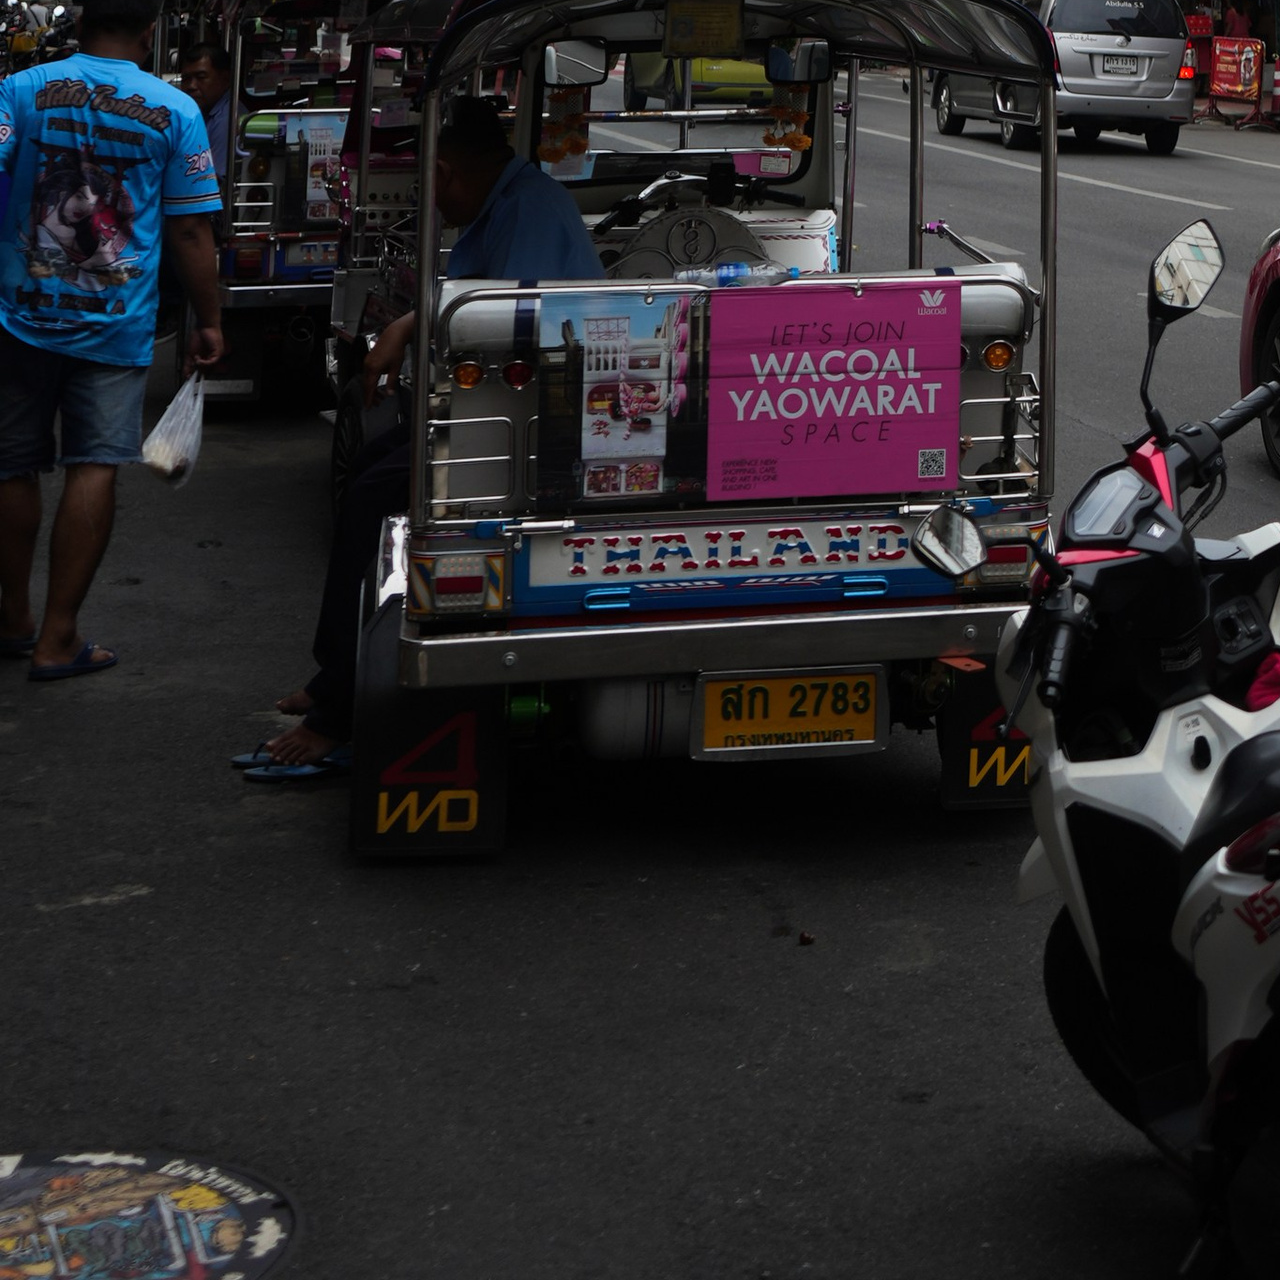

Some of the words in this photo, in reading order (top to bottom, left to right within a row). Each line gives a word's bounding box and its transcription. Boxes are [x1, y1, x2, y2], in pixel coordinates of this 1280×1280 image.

[1105, 0, 1132, 8] Abdulla
[917, 306, 947, 316] Wacoal
[770, 321, 833, 347] LET'S
[842, 320, 906, 347] JOIN
[750, 347, 922, 385] WACOAL
[728, 383, 943, 422] YAOWARAT
[760, 458, 779, 467] NEW
[722, 475, 737, 483] AND
[738, 475, 751, 483] ART
[762, 474, 779, 482] ONE
[561, 523, 909, 577] THAILAND
[721, 683, 770, 720] สก
[789, 680, 871, 718] 2783
[724, 728, 855, 747] กรงเทพมหานคร
